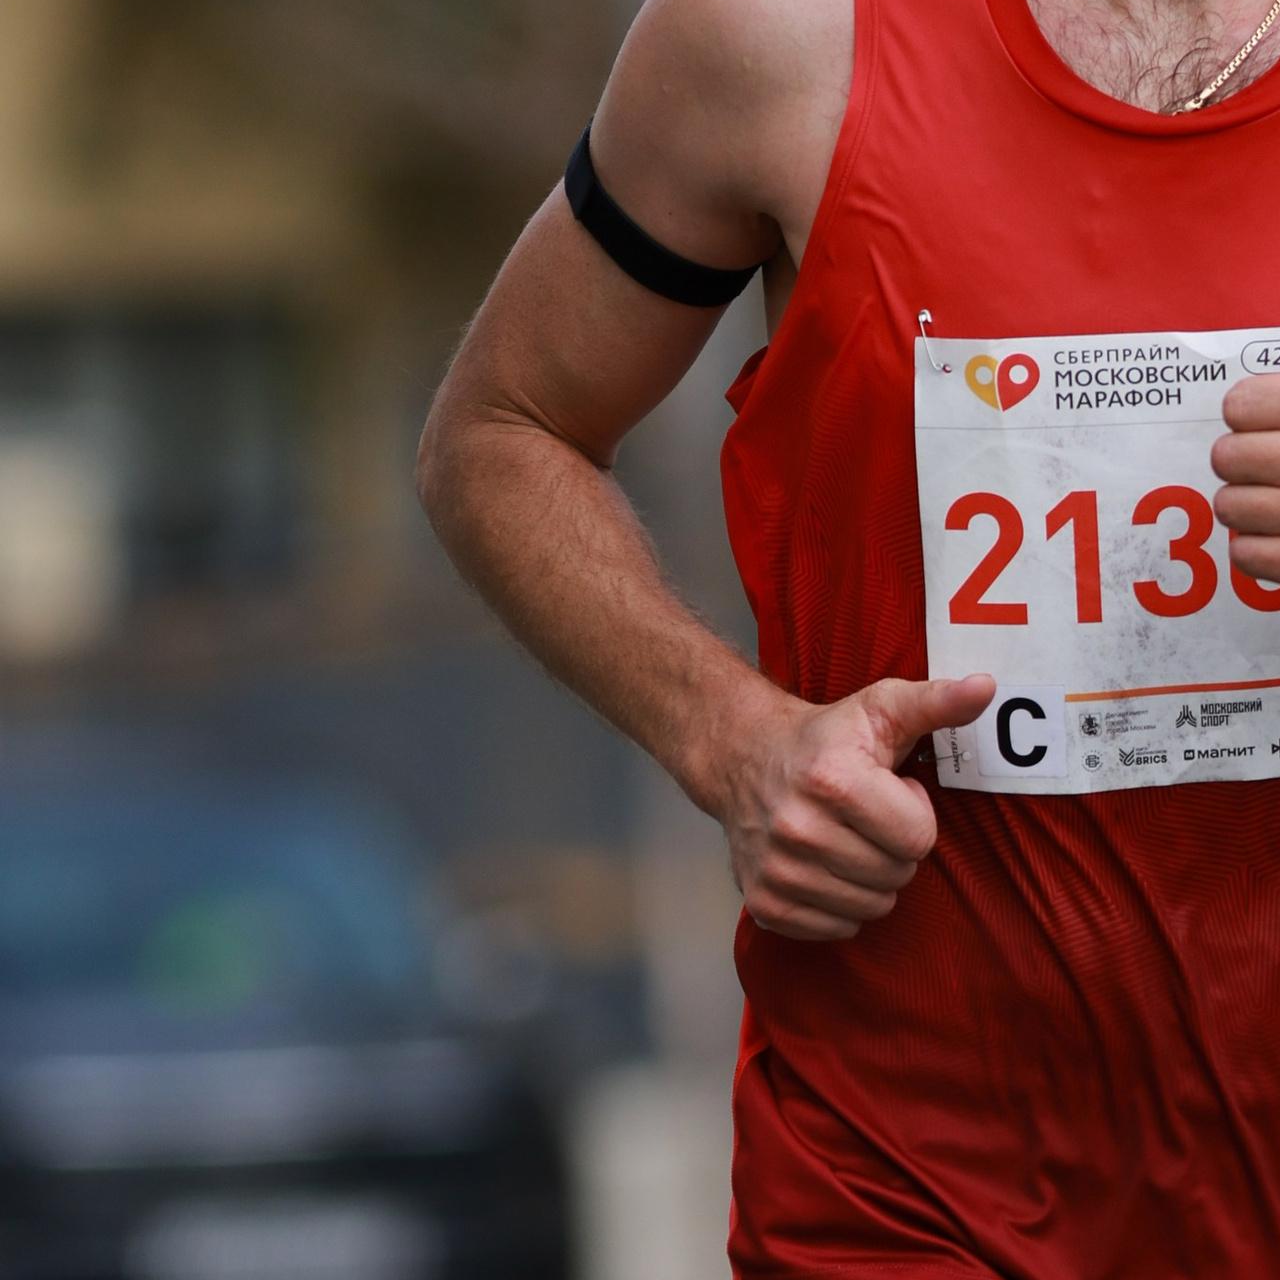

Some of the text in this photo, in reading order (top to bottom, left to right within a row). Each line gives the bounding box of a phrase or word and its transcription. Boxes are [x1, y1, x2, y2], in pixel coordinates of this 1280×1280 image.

[1053, 343, 1180, 365] СБЕРПРАЙМ
[1054, 360, 1227, 388] МОСКОВСКИЙ
[1055, 387, 1182, 410] МАРАФОН
[1200, 698, 1263, 715] МОСКОВСКИЙ
[1200, 714, 1231, 728] СПОРТ
[1135, 754, 1168, 766] BRICS
